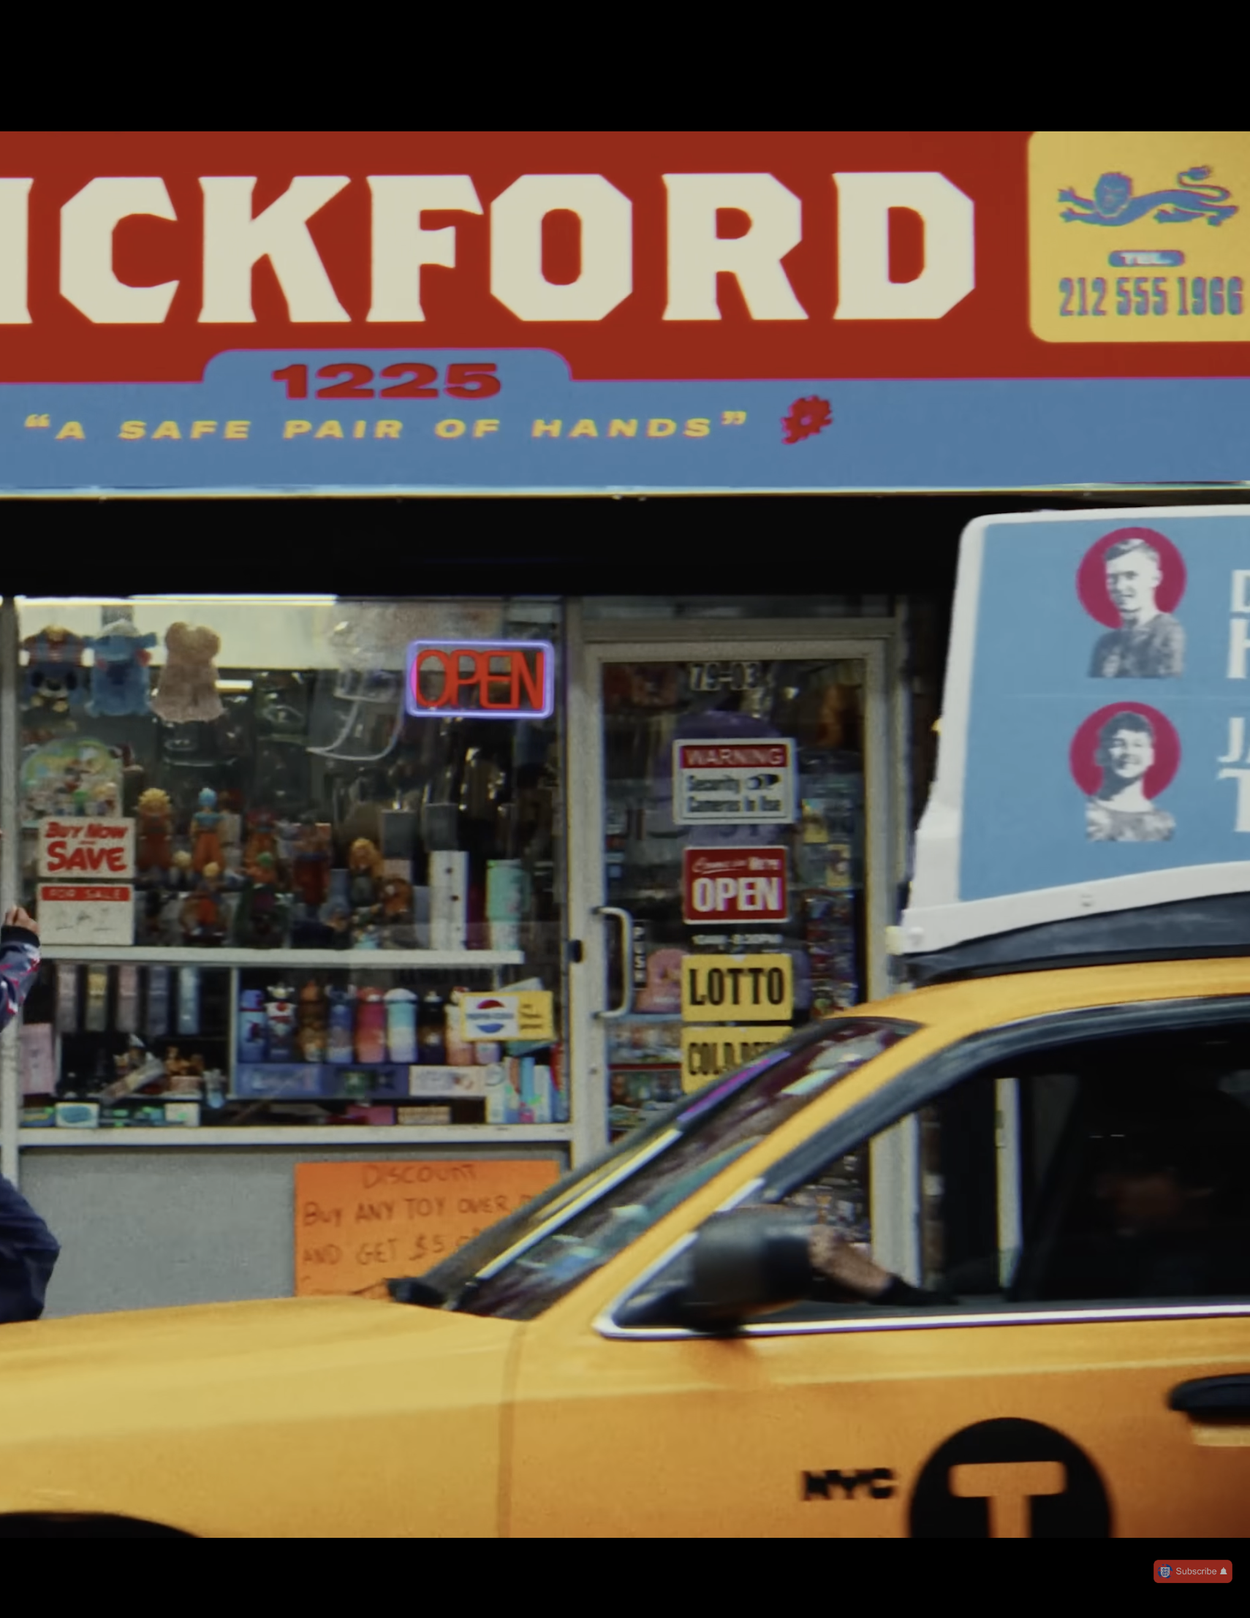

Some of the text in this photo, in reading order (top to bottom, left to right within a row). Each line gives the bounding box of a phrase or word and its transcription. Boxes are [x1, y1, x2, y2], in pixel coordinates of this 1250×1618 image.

[1059, 276, 1244, 316] 212 555 1966
[272, 362, 502, 400] 1225
[118, 420, 251, 440] SAFE
[282, 419, 403, 440] PAIR
[434, 419, 501, 439] OF
[410, 648, 545, 711] OPEN
[685, 748, 784, 766] WARNING
[47, 840, 128, 872] SAVE
[49, 887, 121, 900] FOR SALE
[692, 876, 782, 912] OPEN
[688, 966, 785, 1006] LOTTO
[354, 1202, 395, 1224] ANY
[403, 1197, 447, 1220] TOY
[457, 1194, 511, 1214] OVER
[302, 1243, 342, 1270] AND
[355, 1238, 400, 1270] GET
[801, 1467, 896, 1501] NYC
